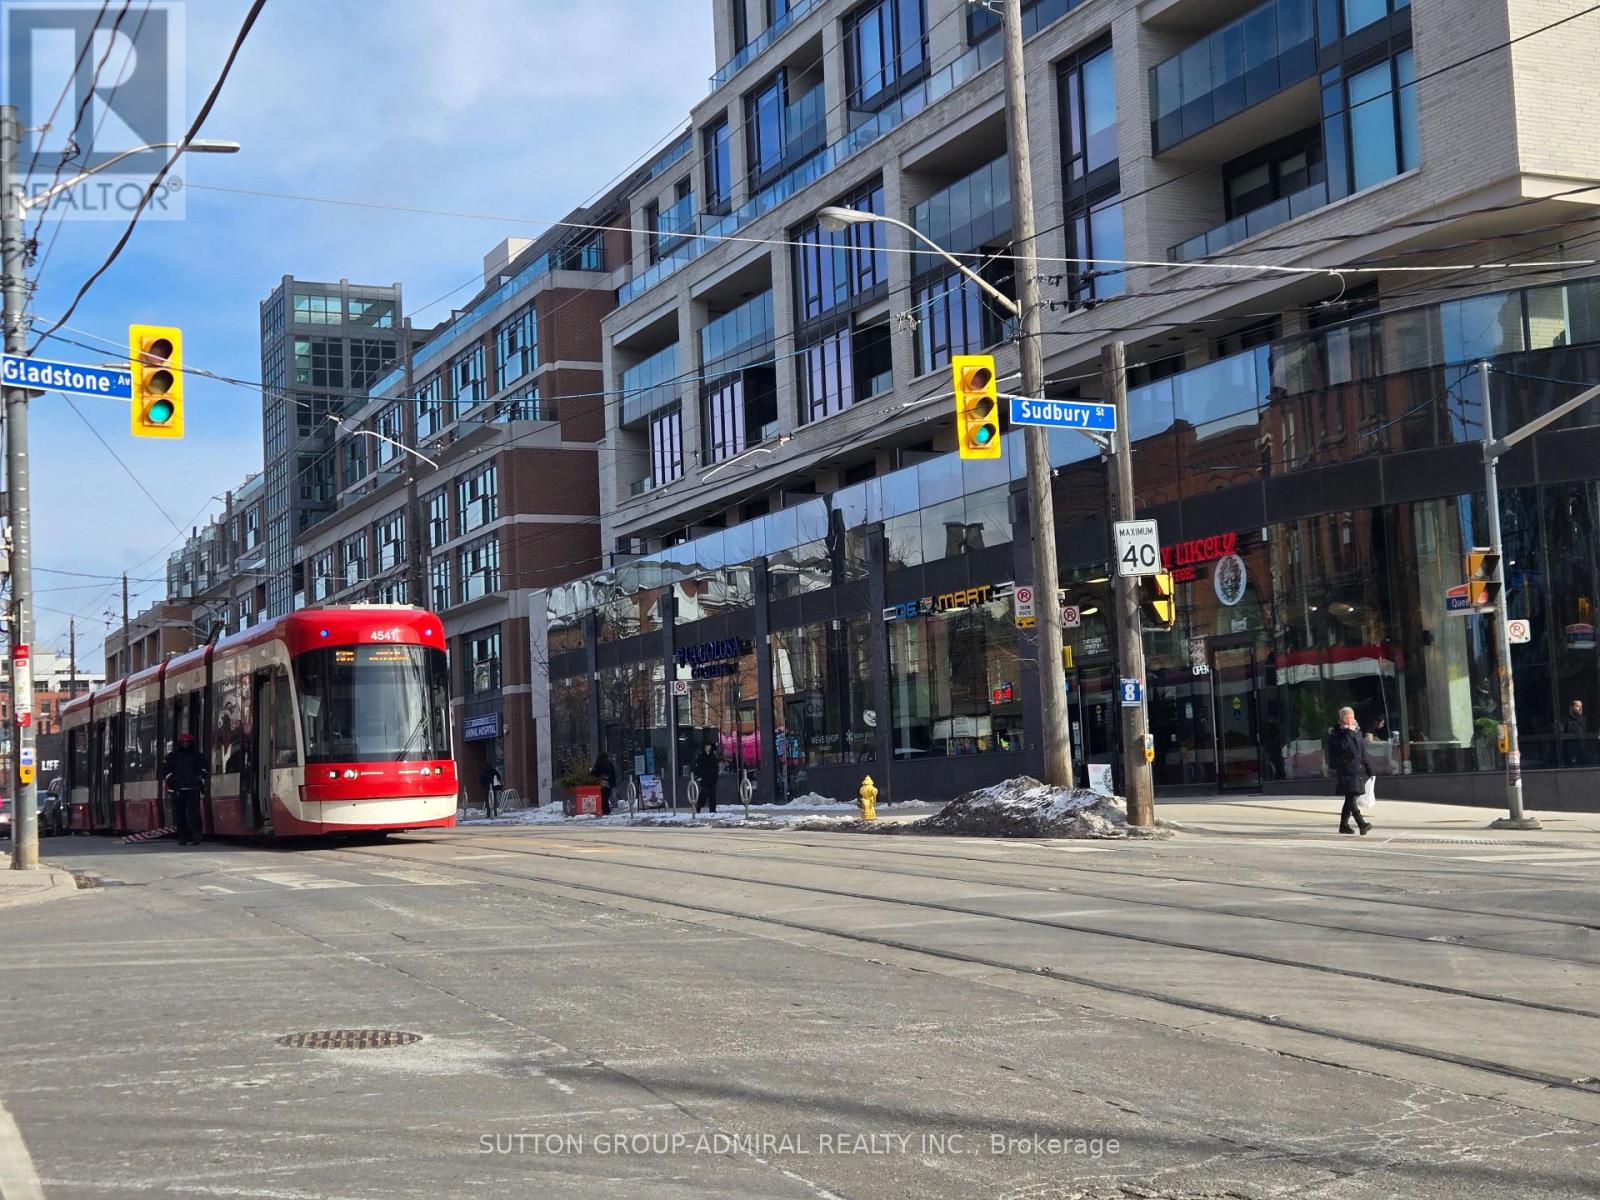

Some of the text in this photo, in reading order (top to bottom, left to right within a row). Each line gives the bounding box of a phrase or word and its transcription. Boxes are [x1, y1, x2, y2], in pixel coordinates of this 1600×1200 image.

[3, 360, 111, 392] Gladstone
[1021, 401, 1105, 427] Sudbury St
[1119, 527, 1154, 537] MAXIMUM
[1122, 543, 1156, 567] 40
[938, 584, 991, 611] MART
[1451, 598, 1471, 608] Quee
[371, 630, 399, 641] 4541
[1192, 664, 1210, 676] OPEN
[1124, 683, 1136, 701] 8
